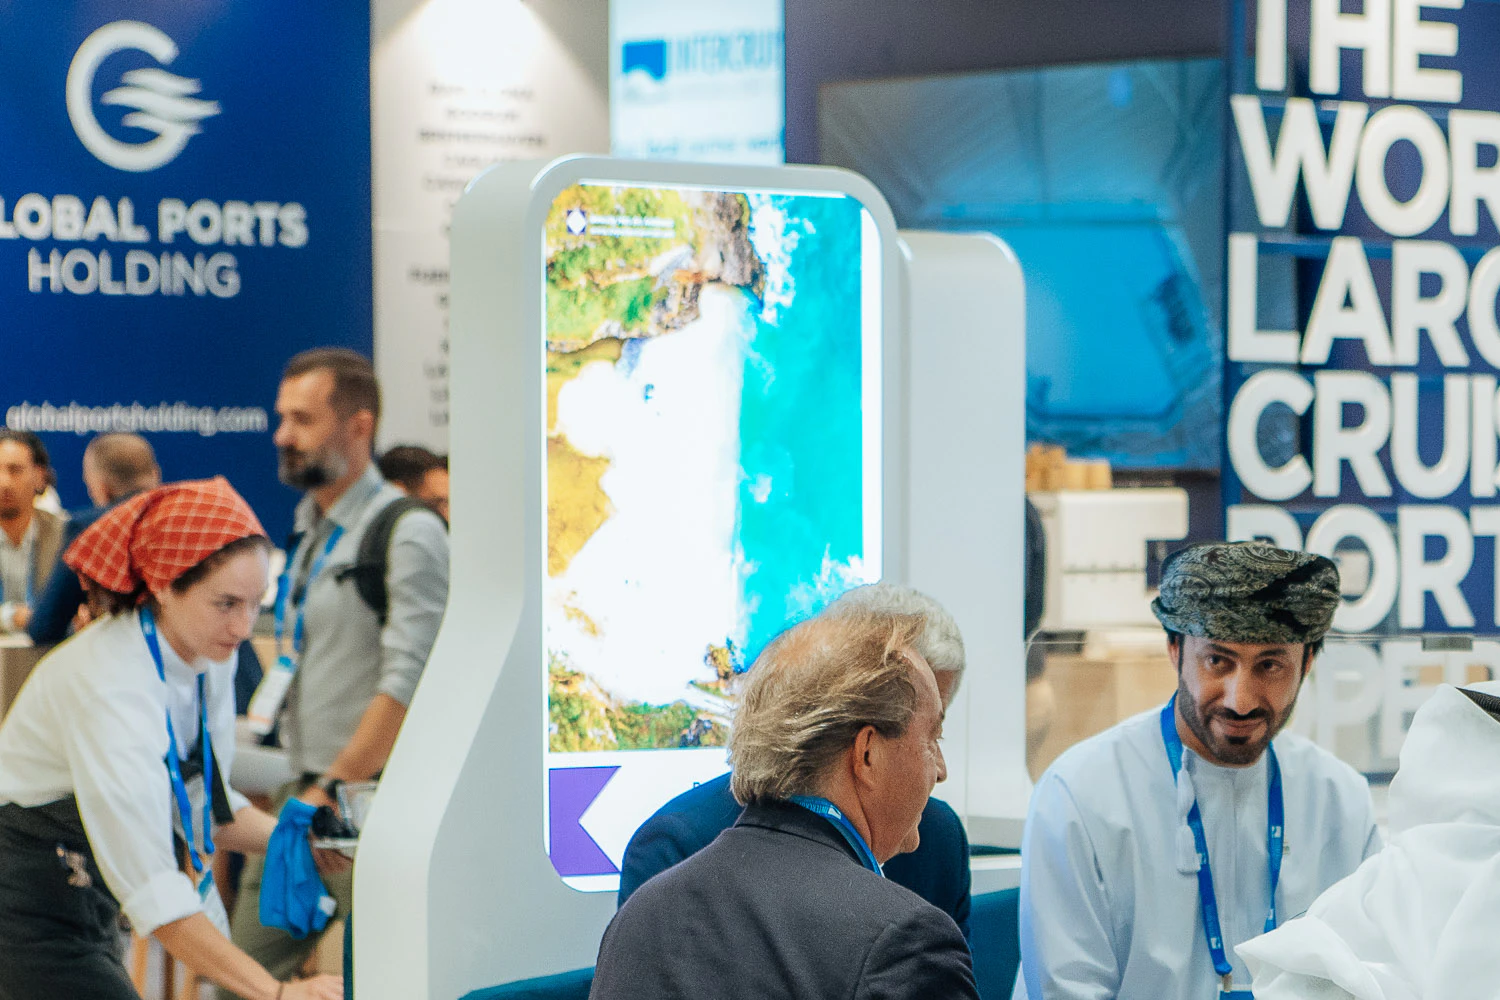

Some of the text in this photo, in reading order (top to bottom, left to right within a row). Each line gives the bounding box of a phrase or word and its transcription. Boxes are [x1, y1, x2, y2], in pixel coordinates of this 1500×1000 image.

[1255, 0, 1464, 103] THE
[0, 193, 309, 248] LOBAL PORTS
[28, 247, 241, 298] HOLDING
[6, 400, 268, 437] globalportsholding.com
